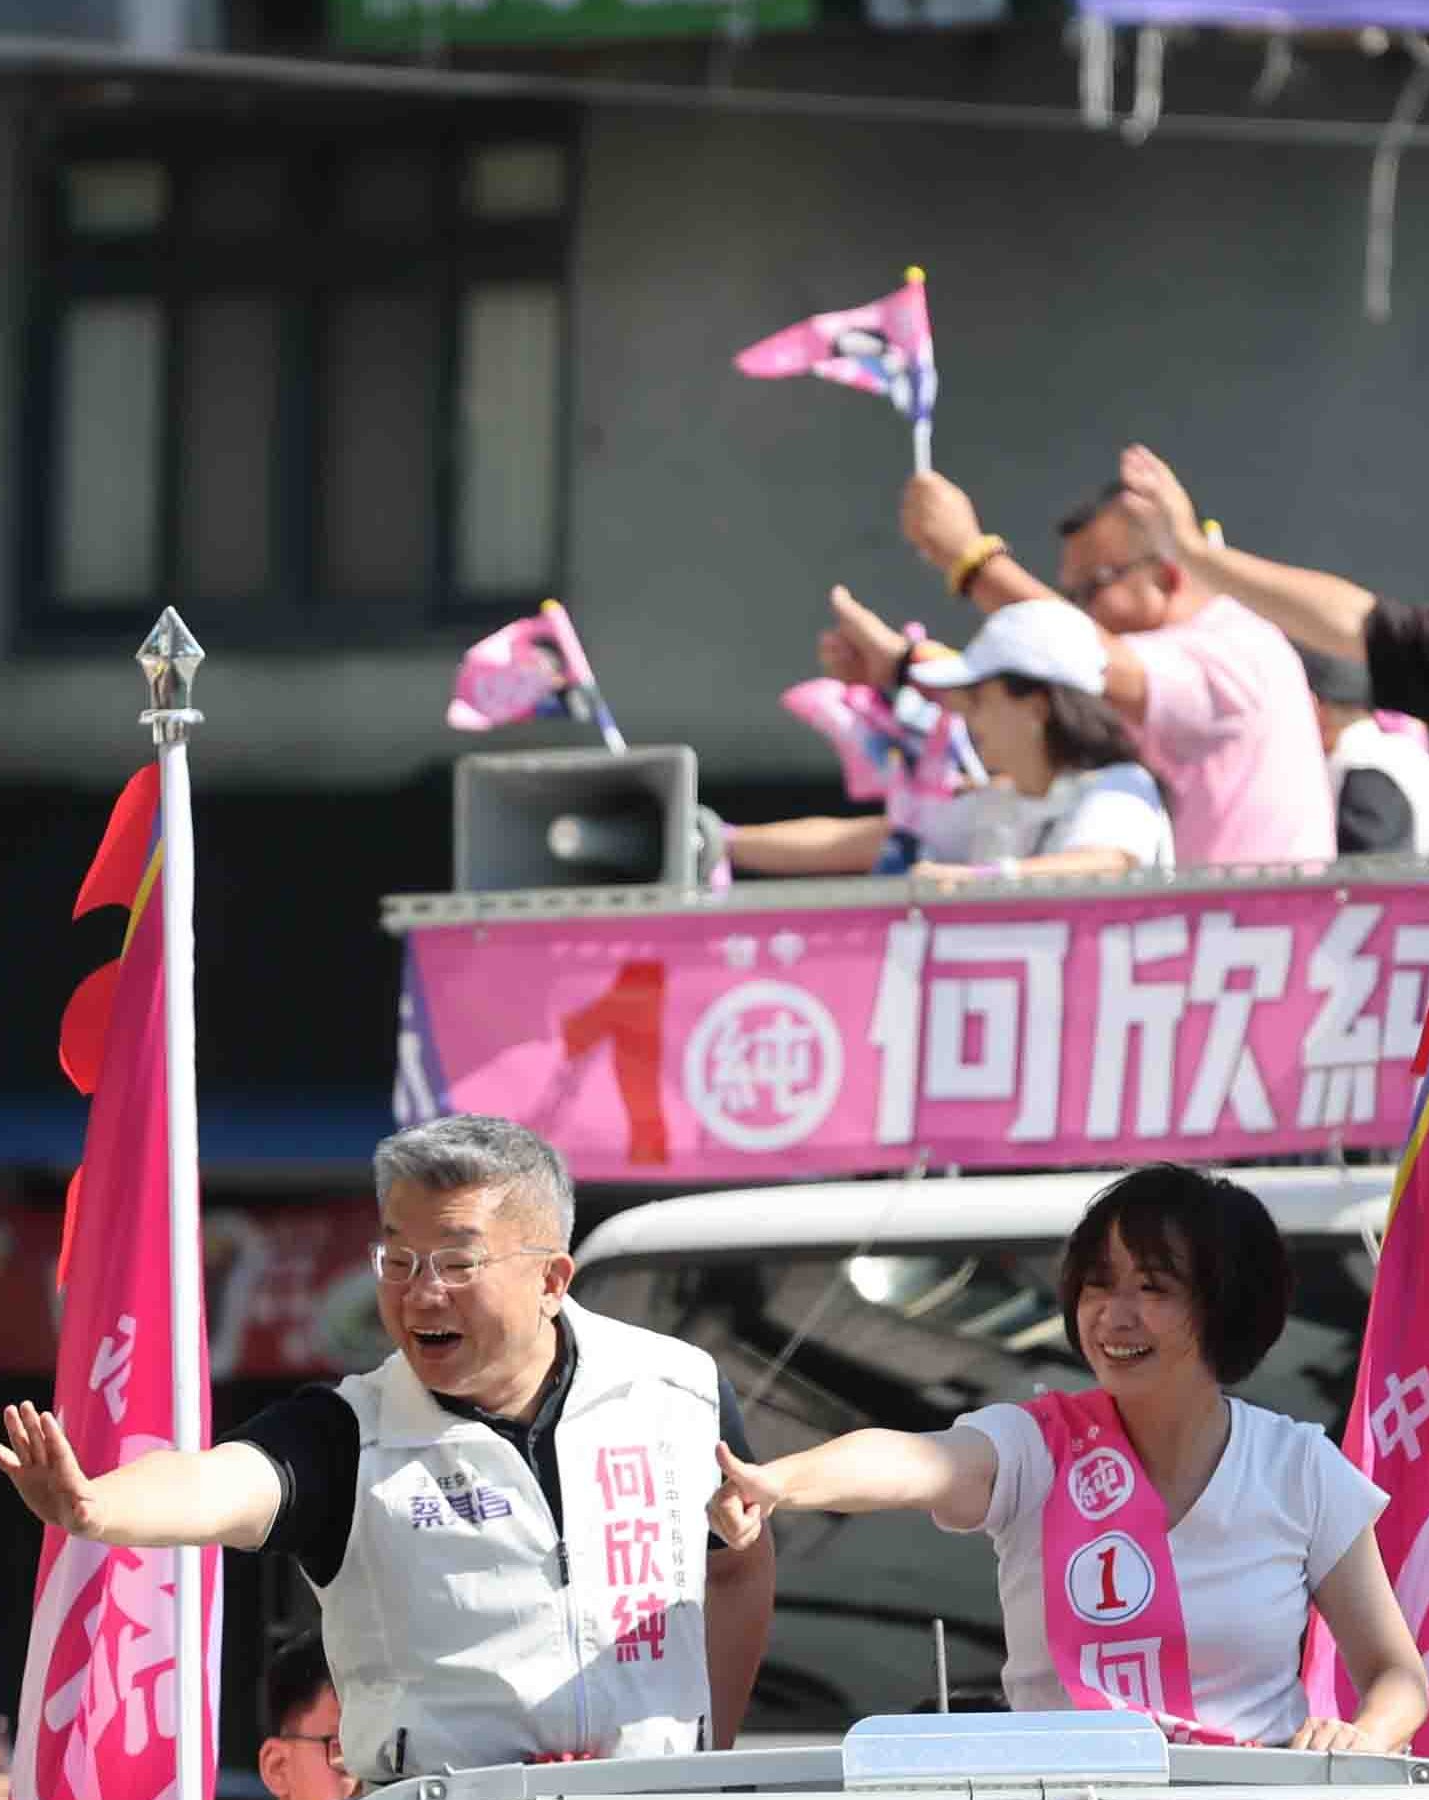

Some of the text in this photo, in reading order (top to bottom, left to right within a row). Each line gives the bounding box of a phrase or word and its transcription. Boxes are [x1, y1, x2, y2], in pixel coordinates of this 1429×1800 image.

[561, 960, 669, 1164] 1
[594, 1443, 669, 1663] 何欣純
[1096, 1546, 1127, 1611] 1
